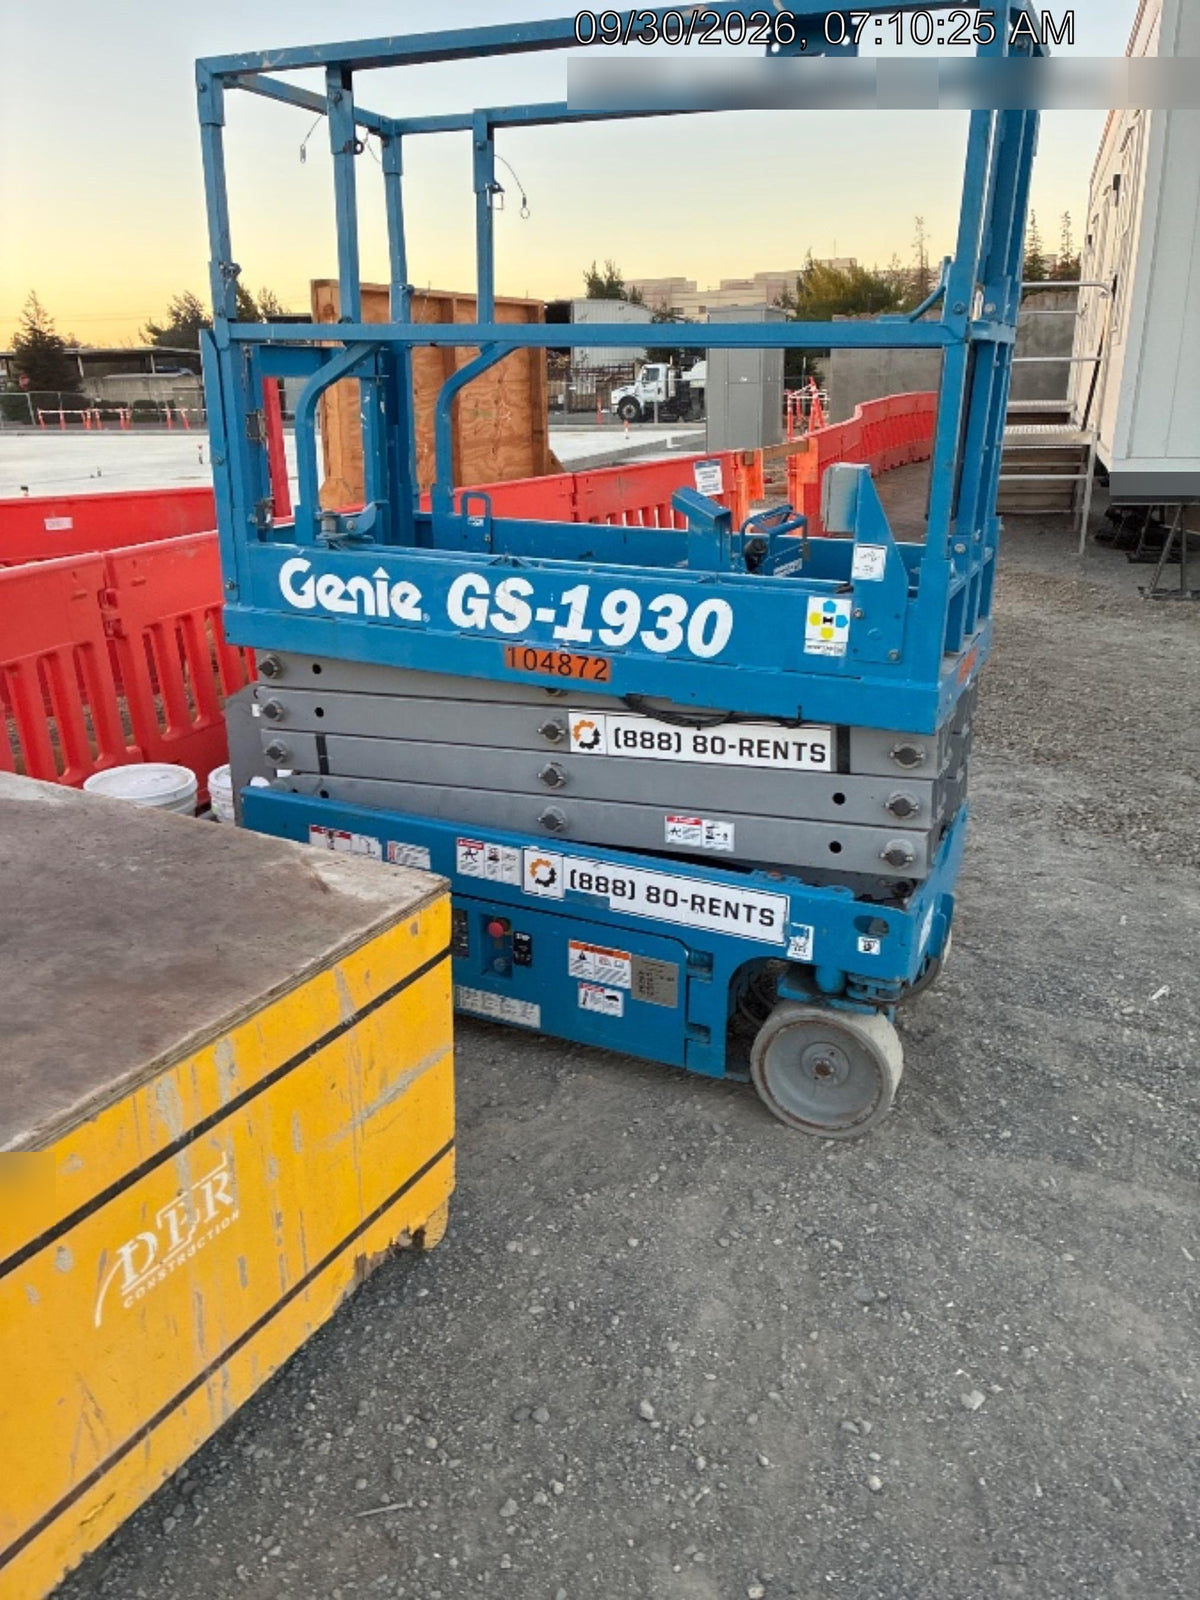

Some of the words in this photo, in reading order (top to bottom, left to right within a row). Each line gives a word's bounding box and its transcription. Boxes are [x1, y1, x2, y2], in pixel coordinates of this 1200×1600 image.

[279, 557, 423, 621] Genie
[446, 572, 734, 658] GS-1930
[613, 727, 682, 753] (888)
[692, 735, 826, 763] 80-RENTS
[569, 868, 636, 900] (888)
[646, 886, 775, 927] 80-RENTS
[123, 1208, 240, 1309] CONSTRUCTION
